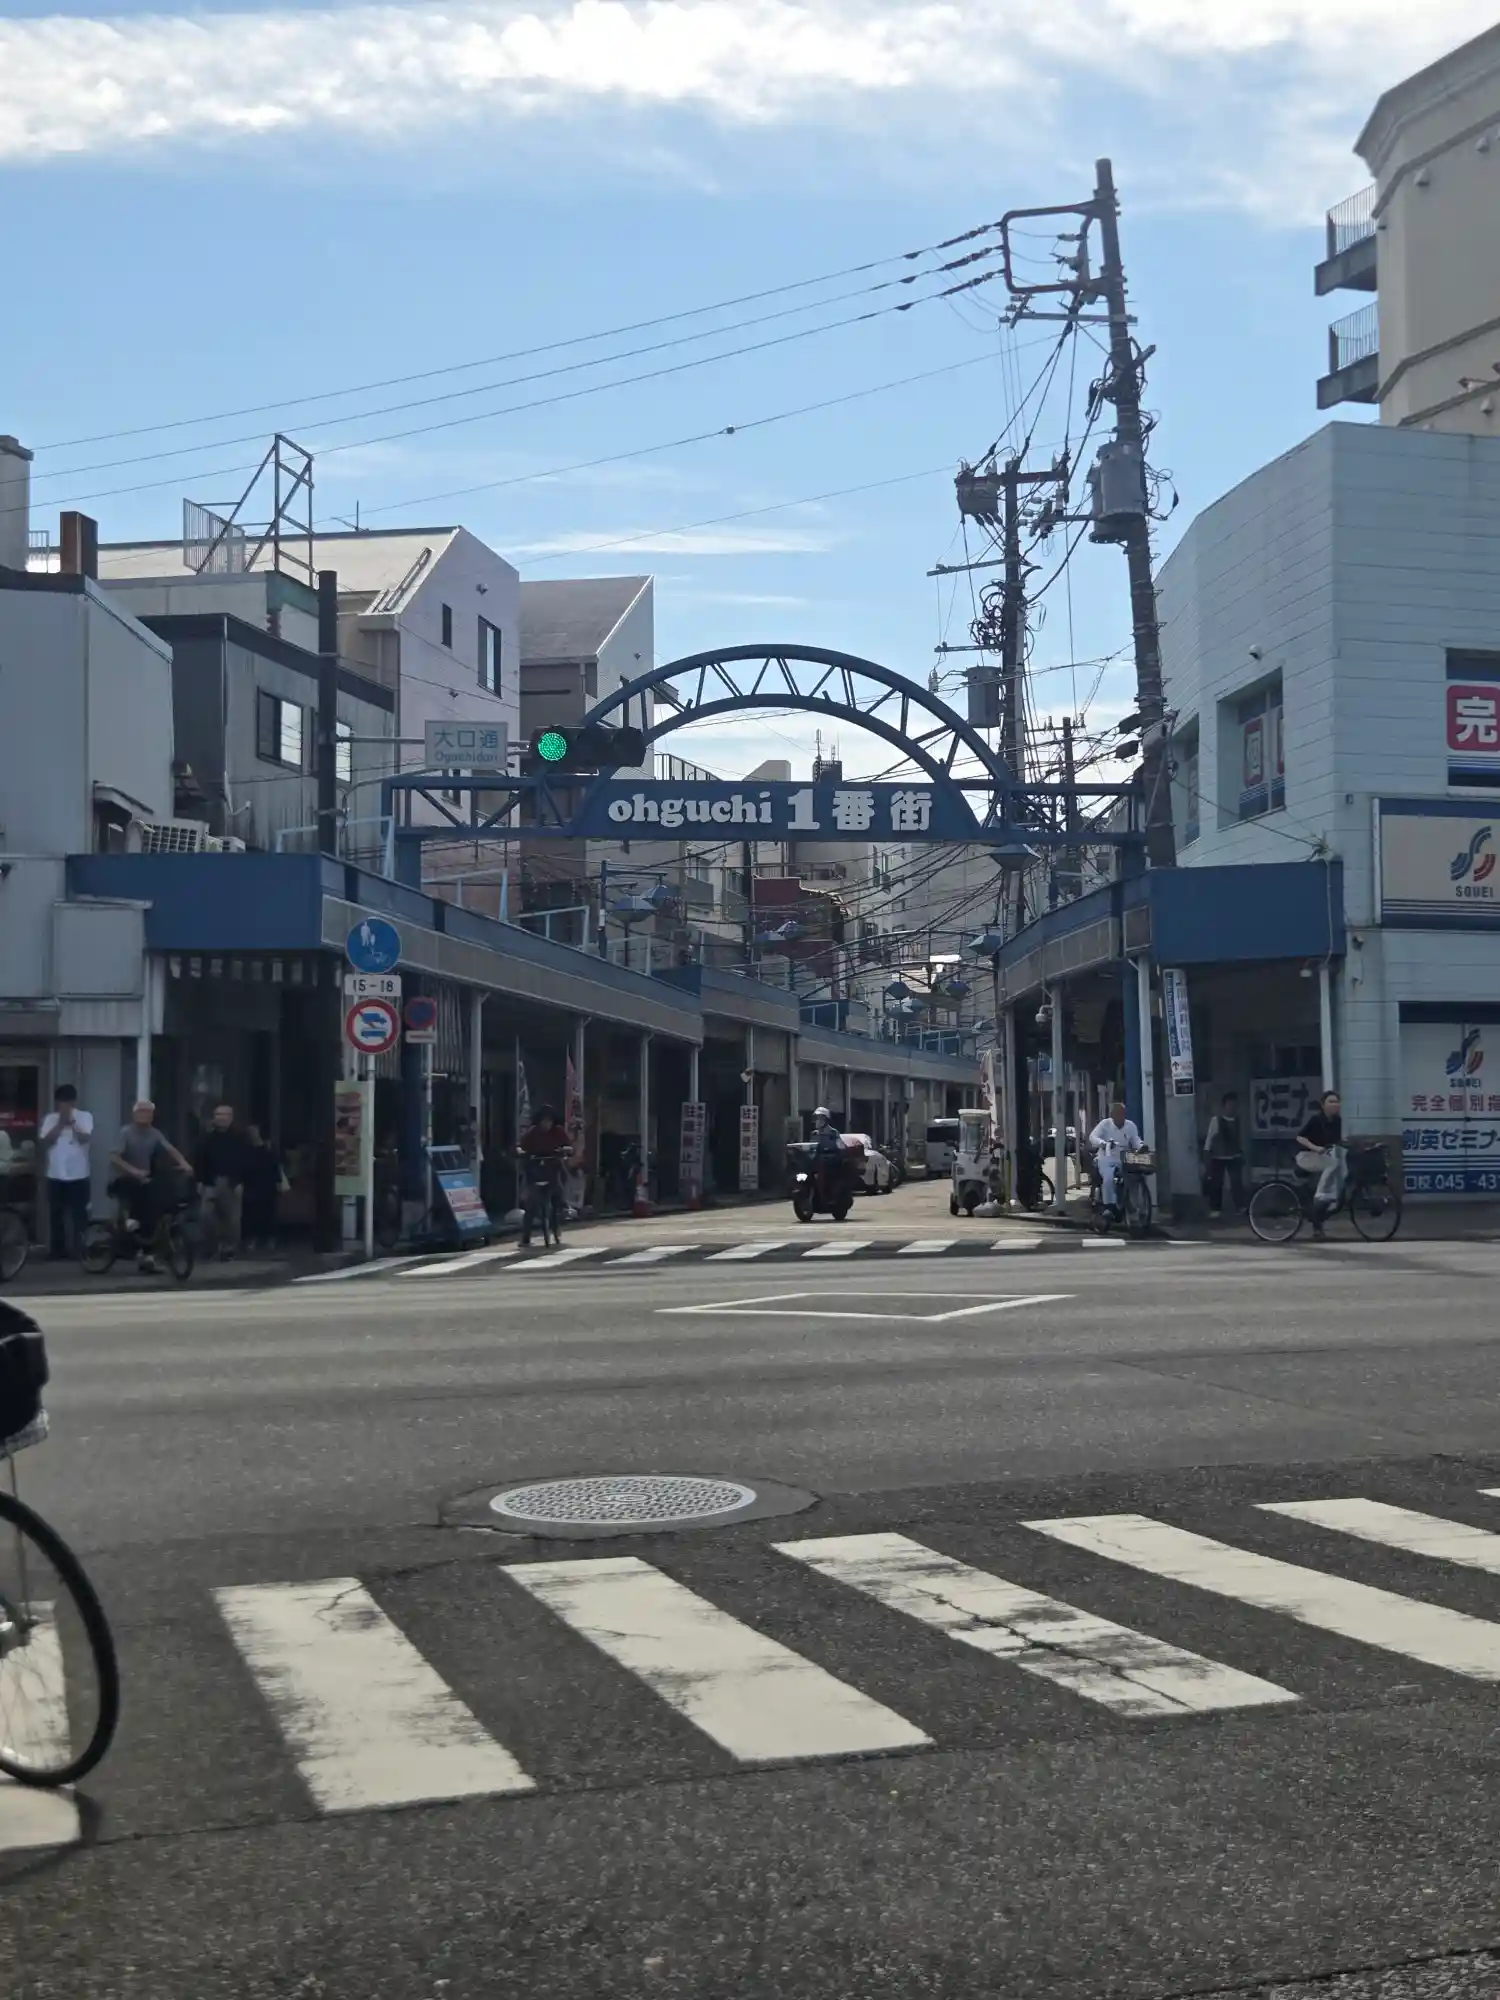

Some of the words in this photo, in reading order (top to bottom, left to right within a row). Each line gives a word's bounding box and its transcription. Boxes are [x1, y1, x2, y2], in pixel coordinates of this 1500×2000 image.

[1456, 696, 1498, 743] 完
[434, 728, 498, 749] 大口通
[608, 791, 773, 827] ohguchi
[787, 788, 933, 831] 1番街
[1402, 1128, 1500, 1151] 創英ゼミナ
